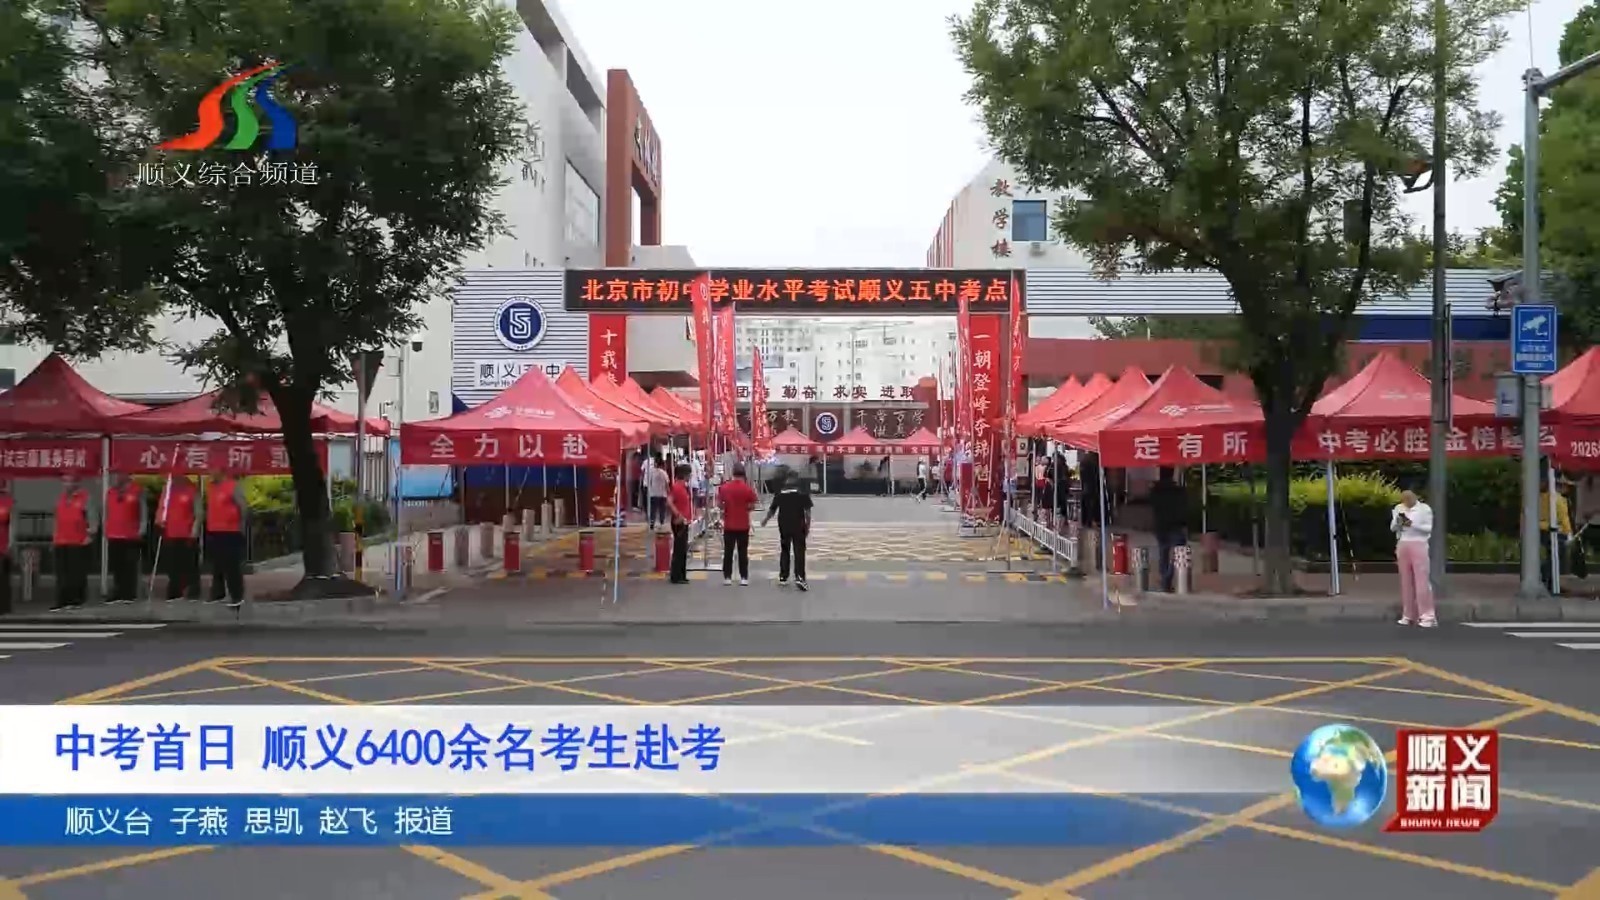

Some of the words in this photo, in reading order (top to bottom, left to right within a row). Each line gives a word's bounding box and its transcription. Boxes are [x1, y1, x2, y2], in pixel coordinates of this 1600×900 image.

[782, 386, 817, 399] 勤奋
[429, 433, 589, 460] 全力以赴
[1317, 427, 1429, 454] 中考必胜
[1570, 441, 1600, 458] 2026
